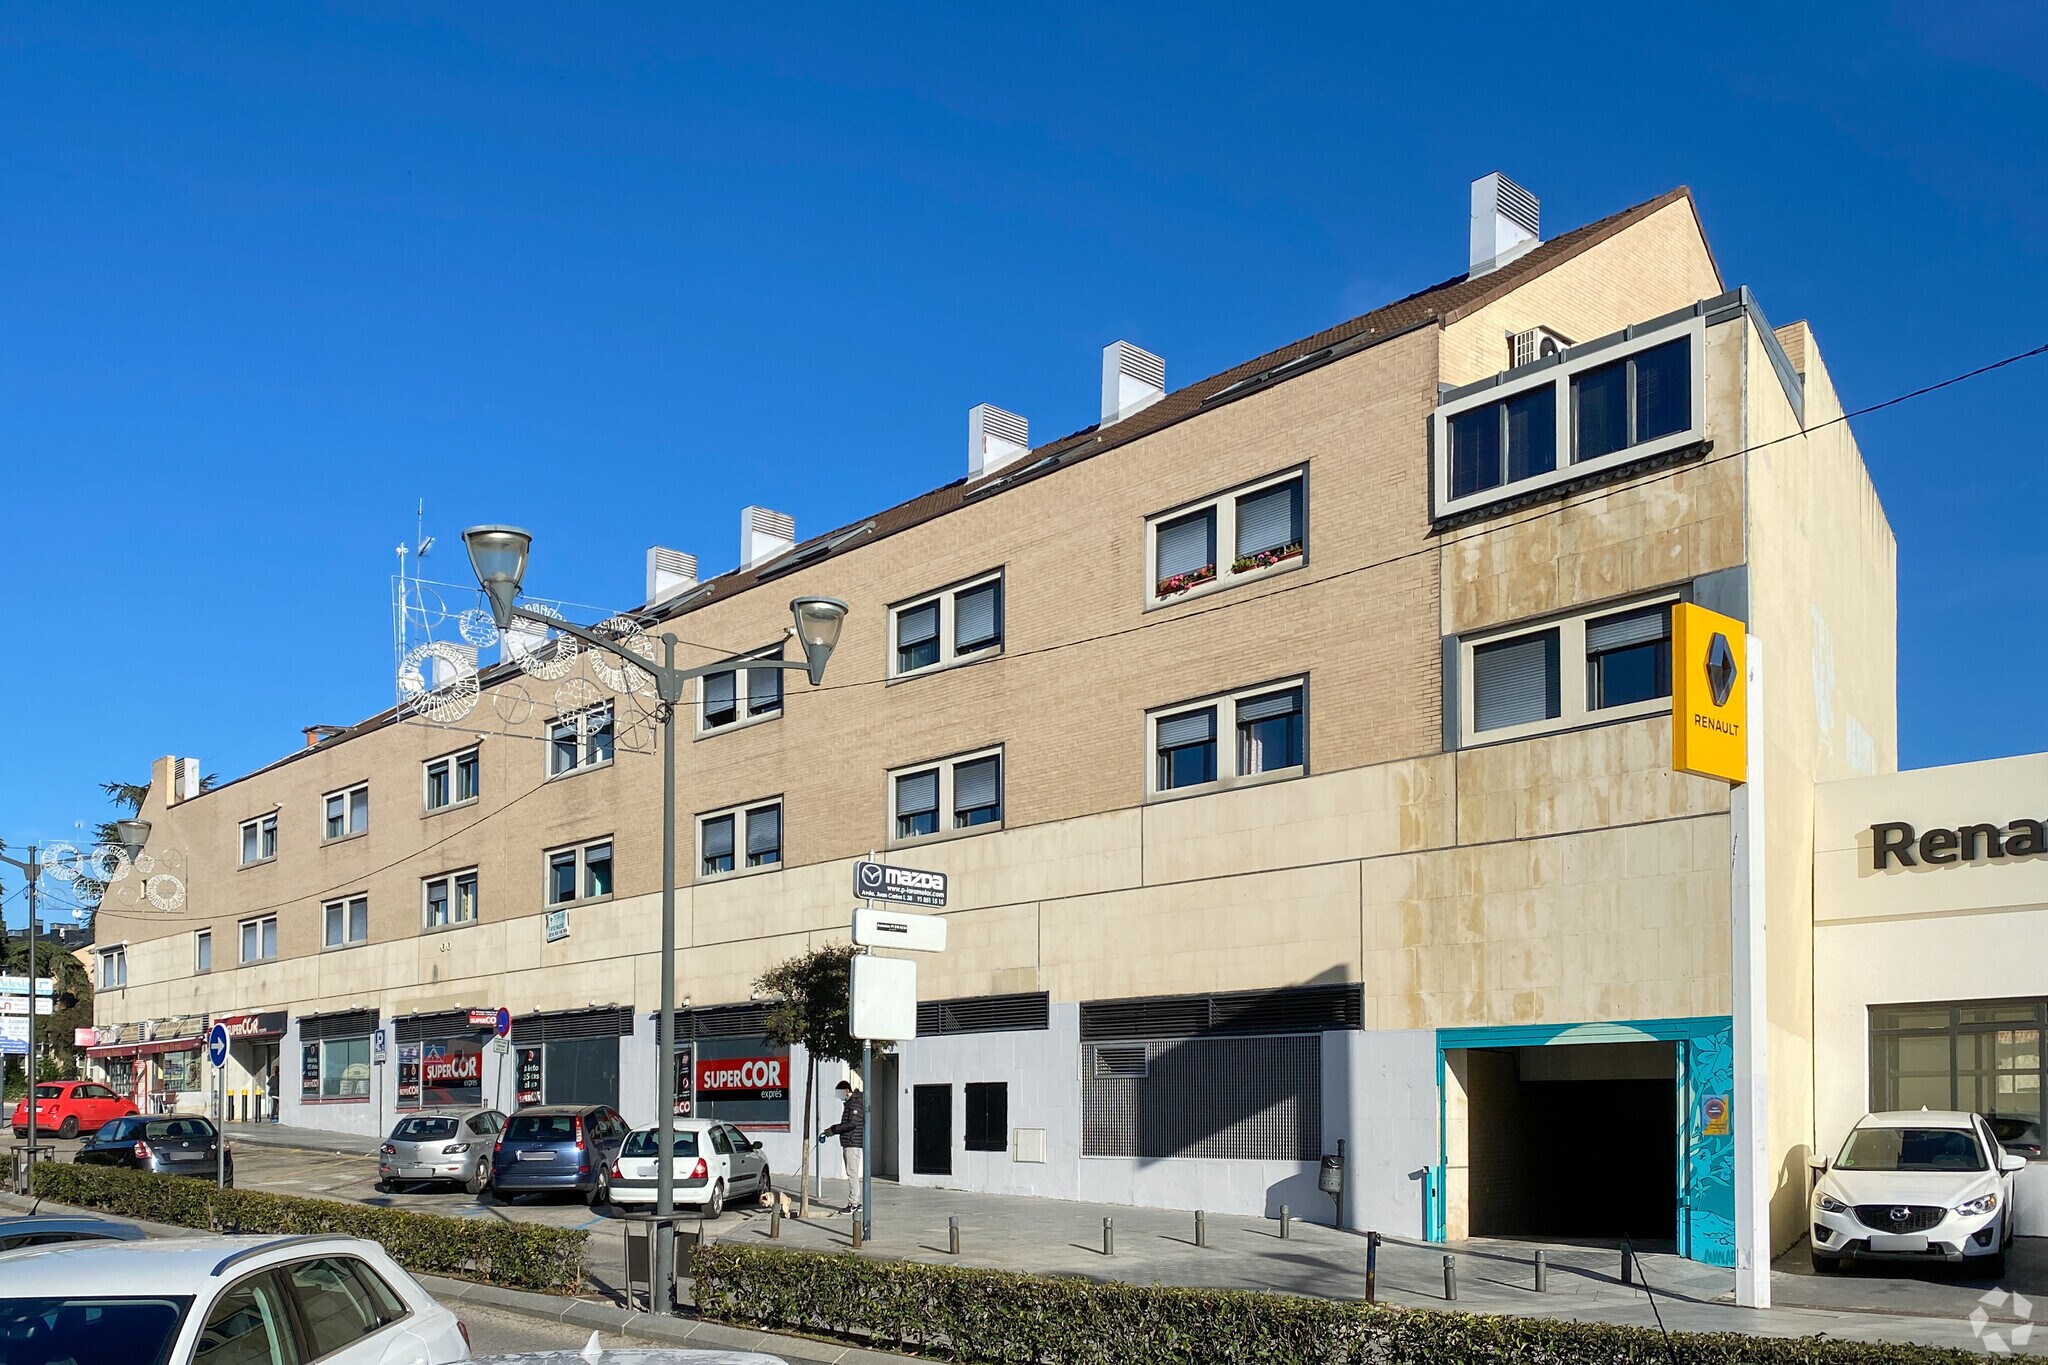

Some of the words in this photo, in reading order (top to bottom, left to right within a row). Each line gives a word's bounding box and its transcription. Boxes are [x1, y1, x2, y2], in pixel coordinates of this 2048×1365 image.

[1694, 713, 1739, 737] RENAULT
[1870, 818, 2048, 870] Rena
[885, 868, 944, 891] mazda
[470, 1016, 497, 1024] SUPERCO
[427, 1056, 477, 1079] SUPERCOR
[704, 1060, 781, 1088] SUPERCOR
[761, 1088, 783, 1100] exprés
